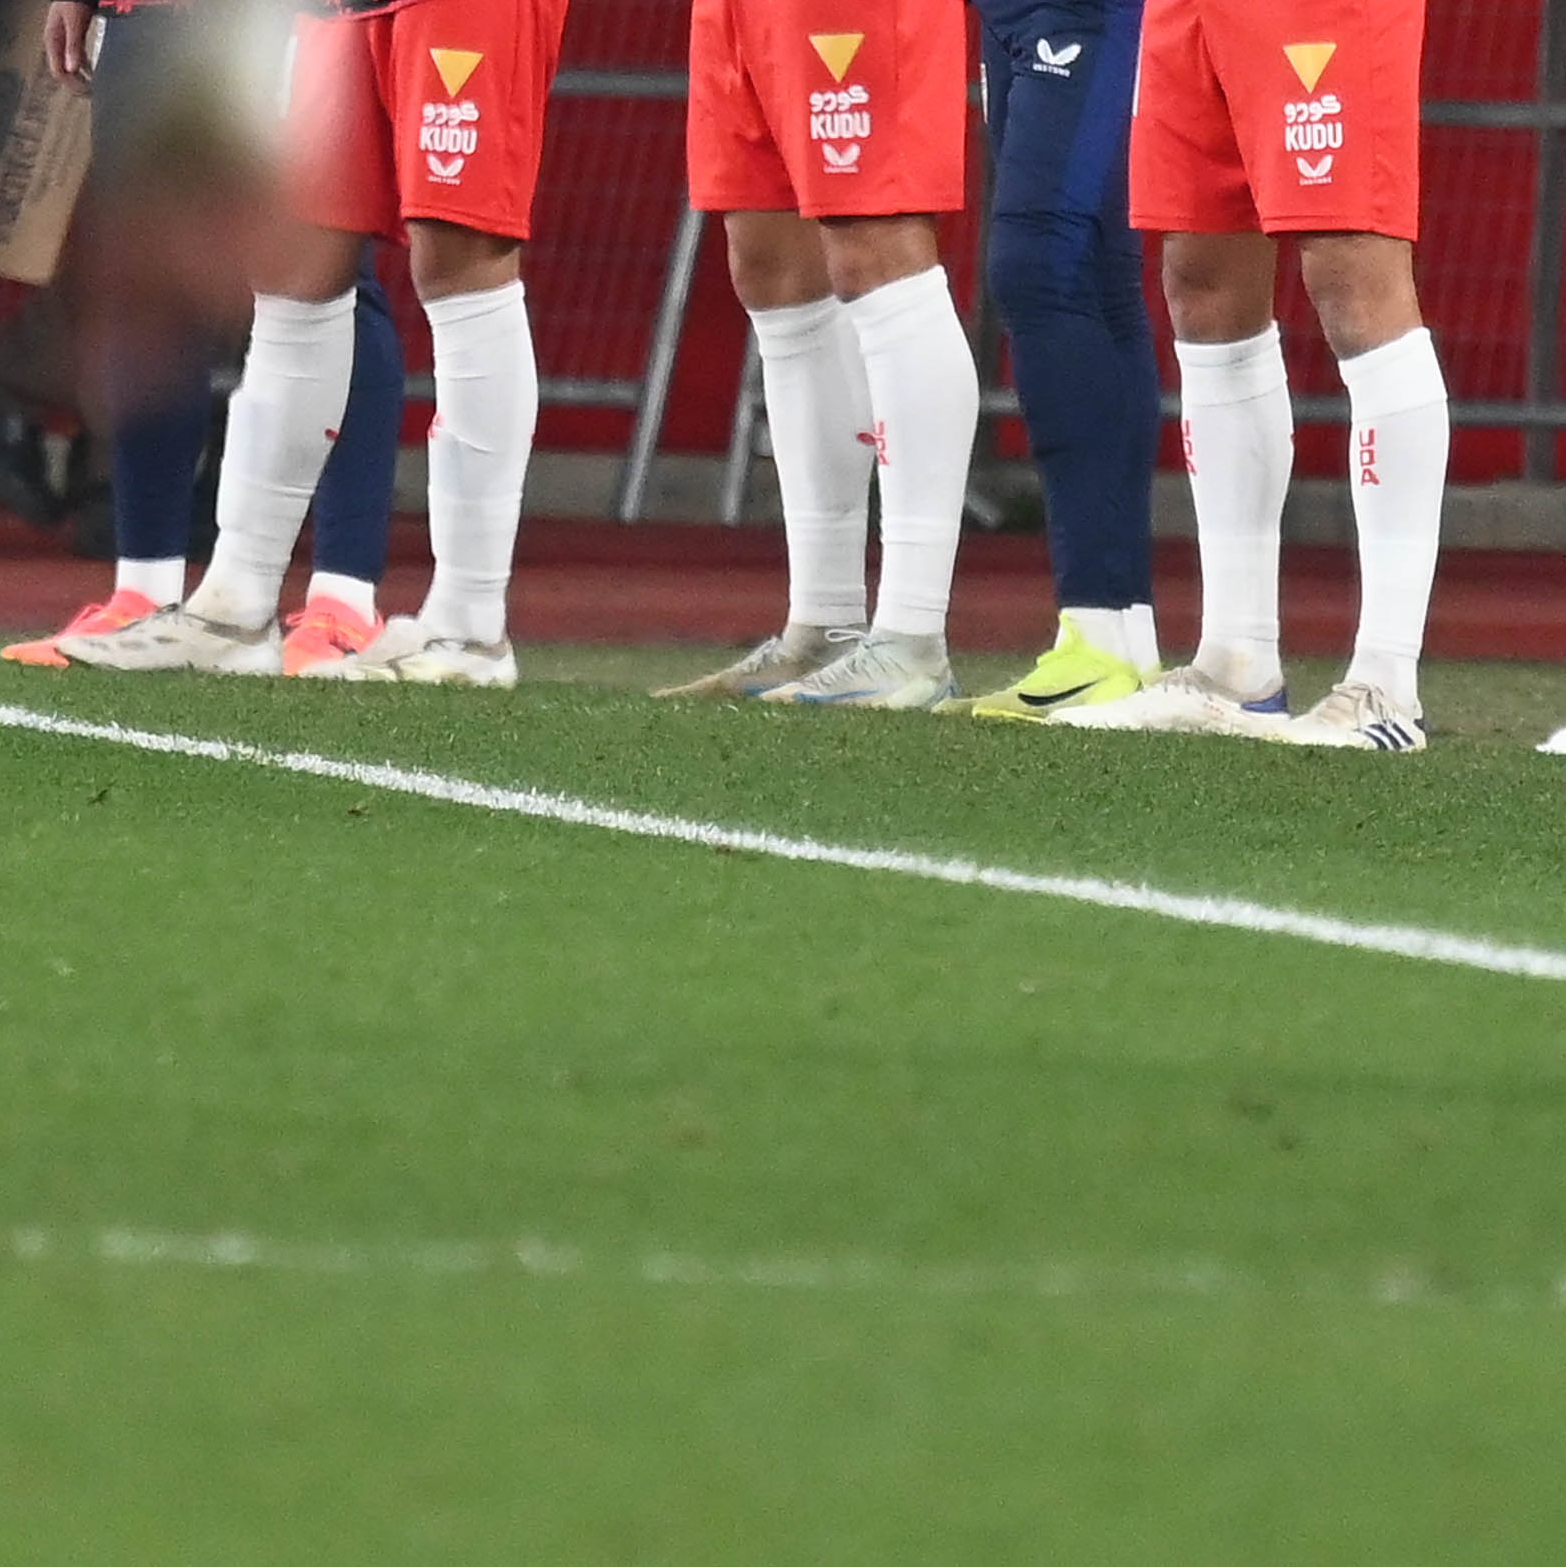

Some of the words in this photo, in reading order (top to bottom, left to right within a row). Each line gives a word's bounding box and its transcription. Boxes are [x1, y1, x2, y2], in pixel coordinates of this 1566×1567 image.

[419, 125, 477, 155] KUDU
[810, 111, 871, 140] KUDU
[1285, 121, 1344, 152] KUDU
[1358, 428, 1381, 486] UDA
